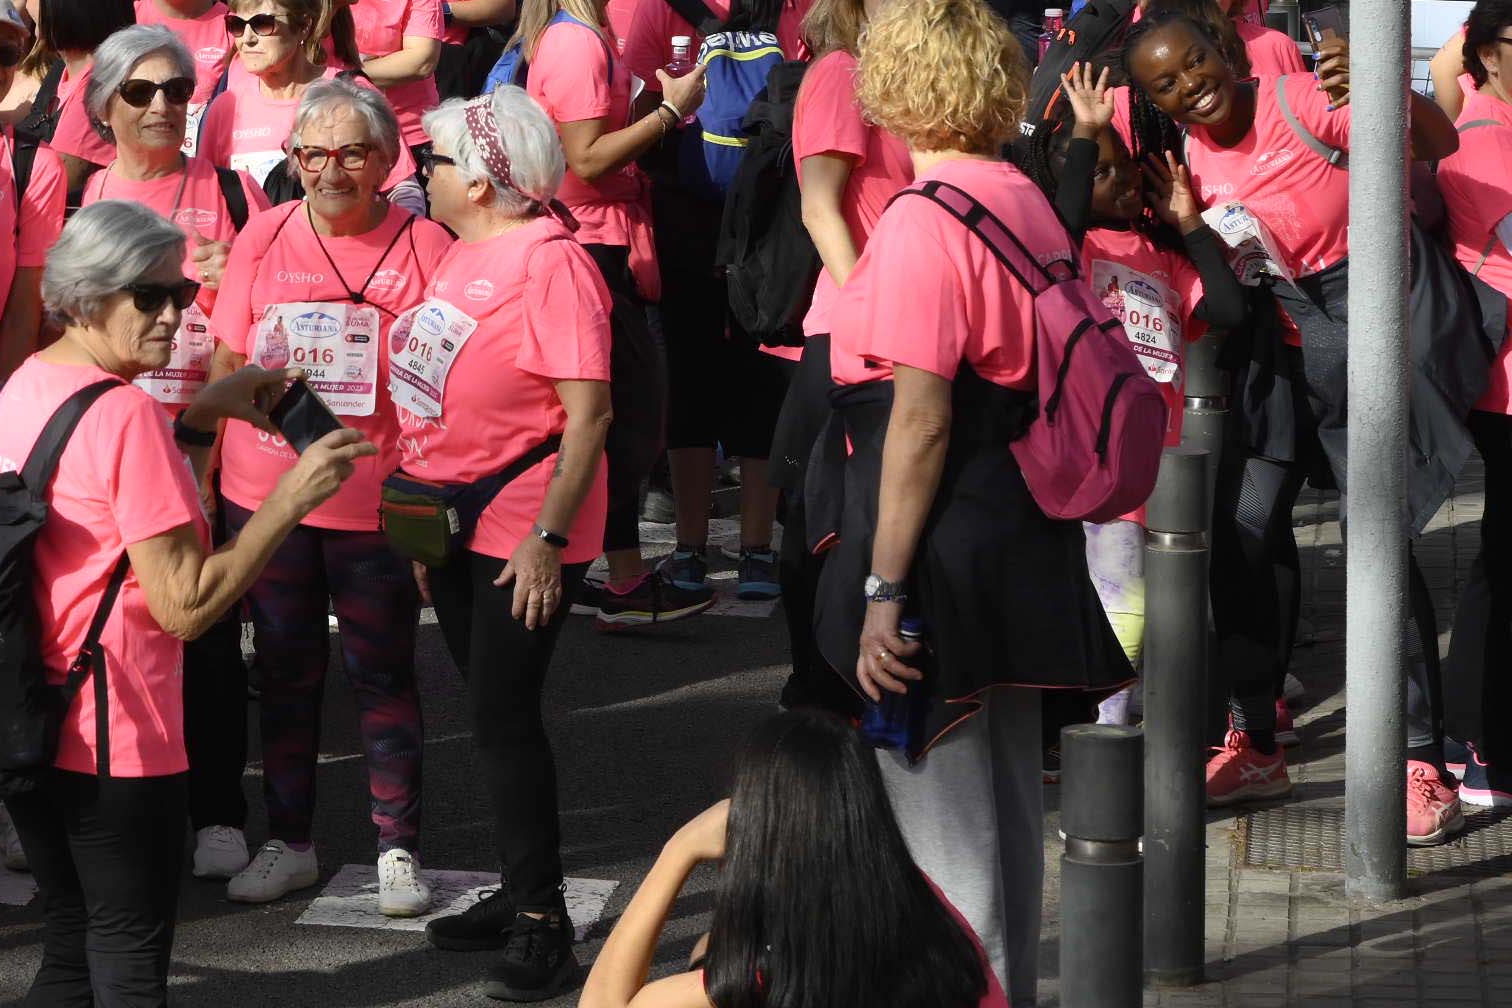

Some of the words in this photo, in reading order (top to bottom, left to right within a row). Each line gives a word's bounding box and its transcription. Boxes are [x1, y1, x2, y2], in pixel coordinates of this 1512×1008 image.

[277, 270, 324, 285] OYSHO
[294, 319, 340, 334] ASTURIANA
[1129, 311, 1164, 332] 016
[1134, 331, 1156, 344] 4824
[293, 347, 334, 365] 016
[409, 337, 432, 362] 016
[408, 359, 426, 376] 4845
[320, 383, 344, 392] MUJER
